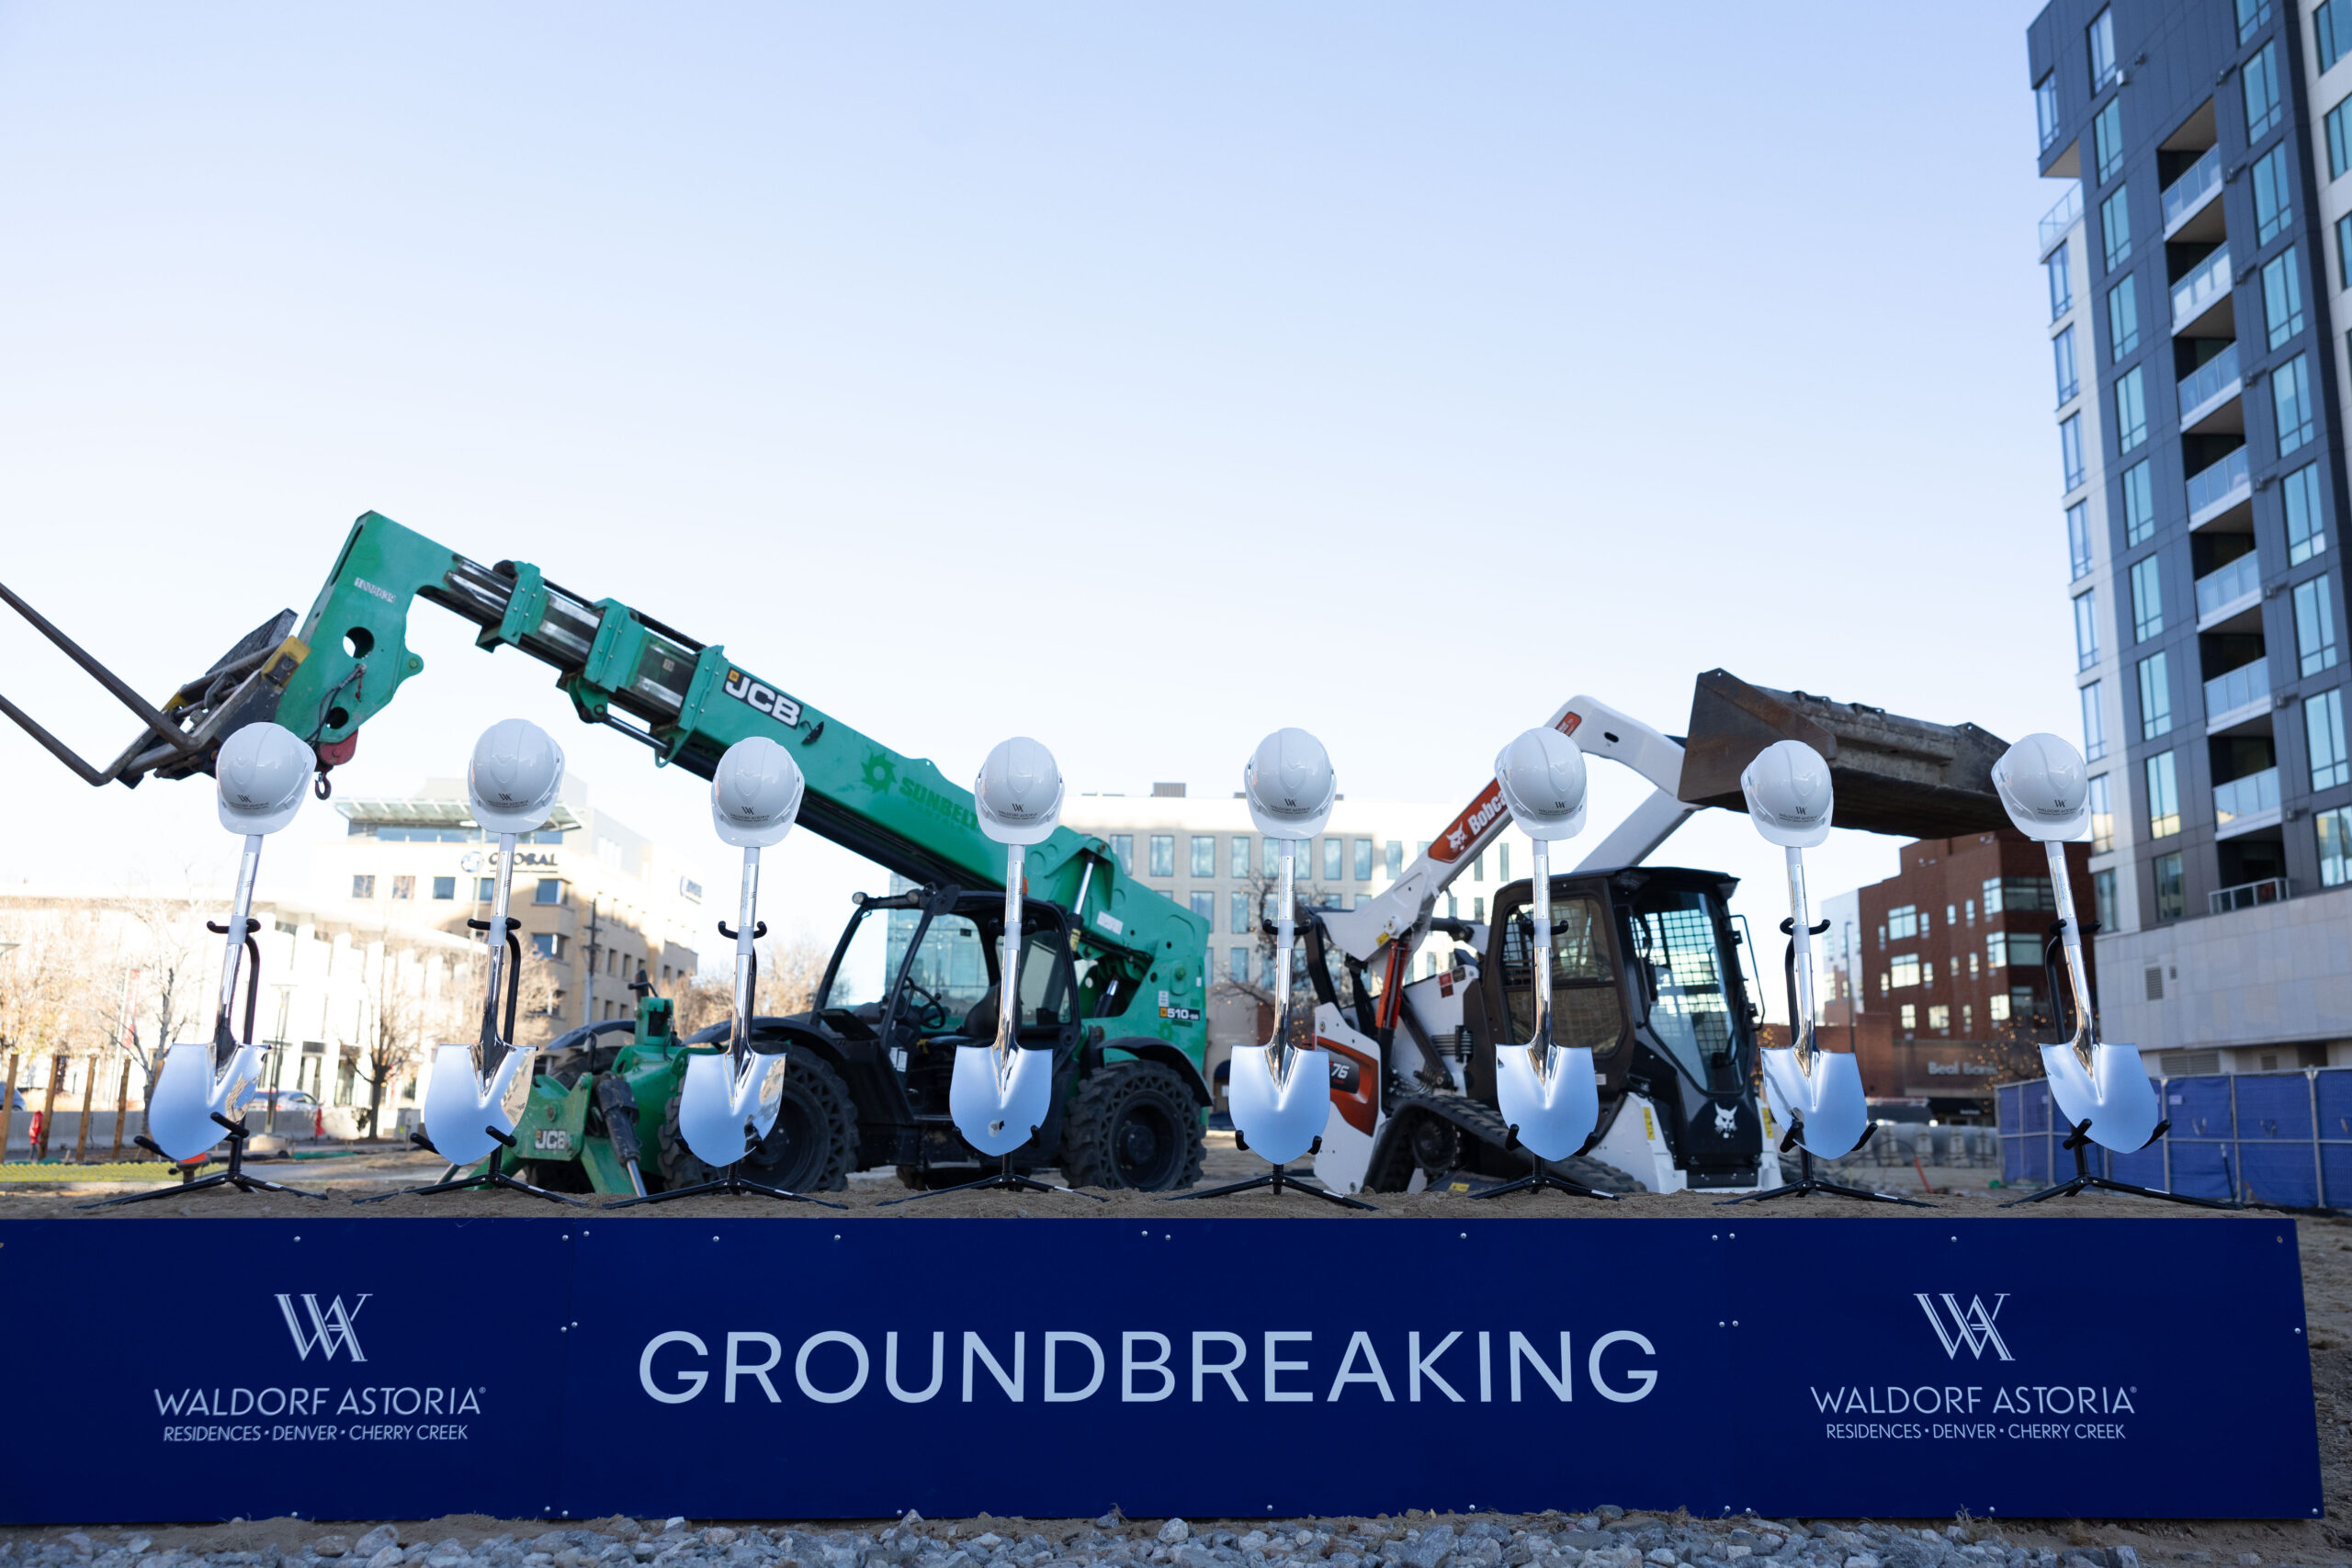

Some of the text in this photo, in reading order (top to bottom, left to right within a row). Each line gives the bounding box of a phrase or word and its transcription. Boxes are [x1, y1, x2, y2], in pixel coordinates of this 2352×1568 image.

[725, 675, 800, 727] JCB
[899, 776, 978, 831] SUNBELT
[1467, 790, 1508, 836] Bobca
[489, 852, 559, 865] GOBAL
[1329, 1062, 1350, 1079] 76
[535, 1130, 567, 1149] JCB
[639, 1329, 1658, 1404] GROUNDBREAKING
[153, 1387, 330, 1416] WALDORF
[1810, 1386, 1983, 1415] WALDORF
[164, 1424, 469, 1441] RESIDENCES DENVER CHERRY CREEK
[1826, 1424, 2126, 1439] RESIDENCES DENVER CHERRY CREEK
